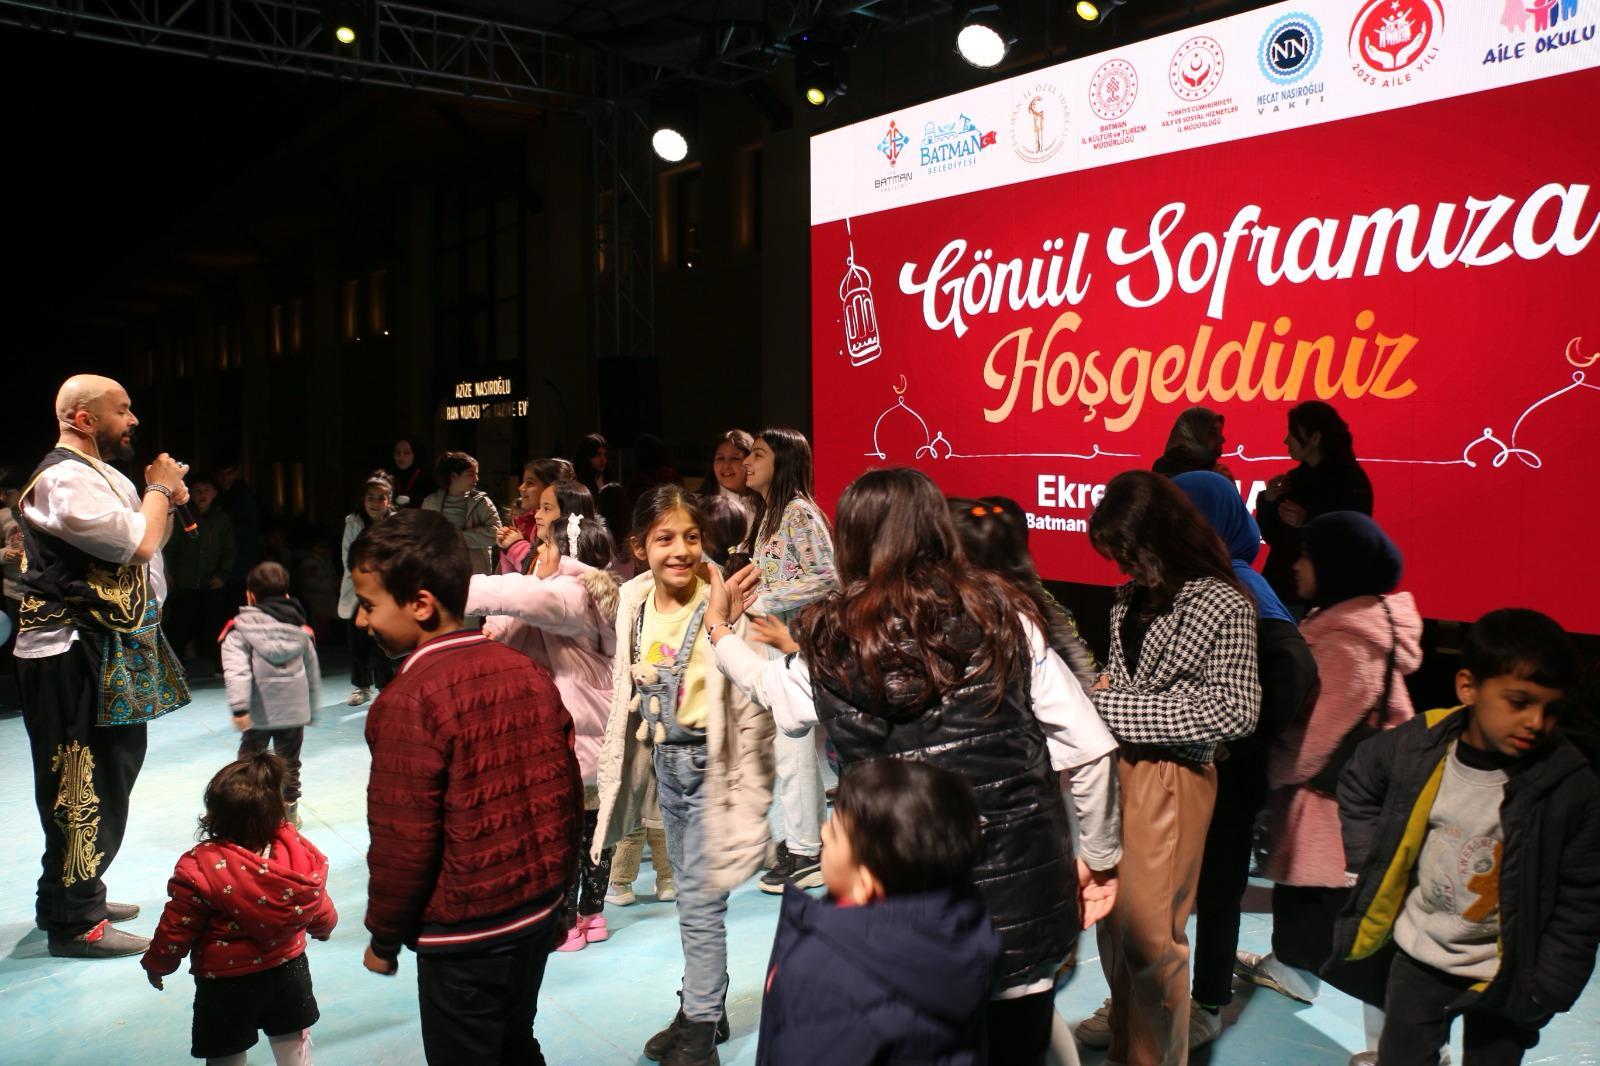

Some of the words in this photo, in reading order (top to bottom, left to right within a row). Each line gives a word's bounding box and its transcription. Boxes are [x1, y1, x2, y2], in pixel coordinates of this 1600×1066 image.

[1272, 37, 1307, 62] NN
[1482, 41, 1525, 66] AİLE
[1535, 24, 1596, 54] OKULU
[1352, 63, 1377, 86] 2025
[1416, 47, 1439, 72] YILI
[1257, 96, 1324, 115] VAKFI
[1100, 120, 1127, 133] BATMAN
[920, 133, 982, 167] BATMAN
[928, 156, 976, 174] BELEDİYESİ
[874, 172, 912, 188] BATMAN
[899, 231, 1092, 339] Gönül
[1106, 182, 1600, 320] Soframıza
[983, 309, 1420, 433] Hoşgeldiniz
[455, 381, 473, 399] AZİZE
[475, 376, 511, 397] NASIROĞLU
[1038, 474, 1106, 509] Ekre
[1025, 512, 1087, 533] Batman
